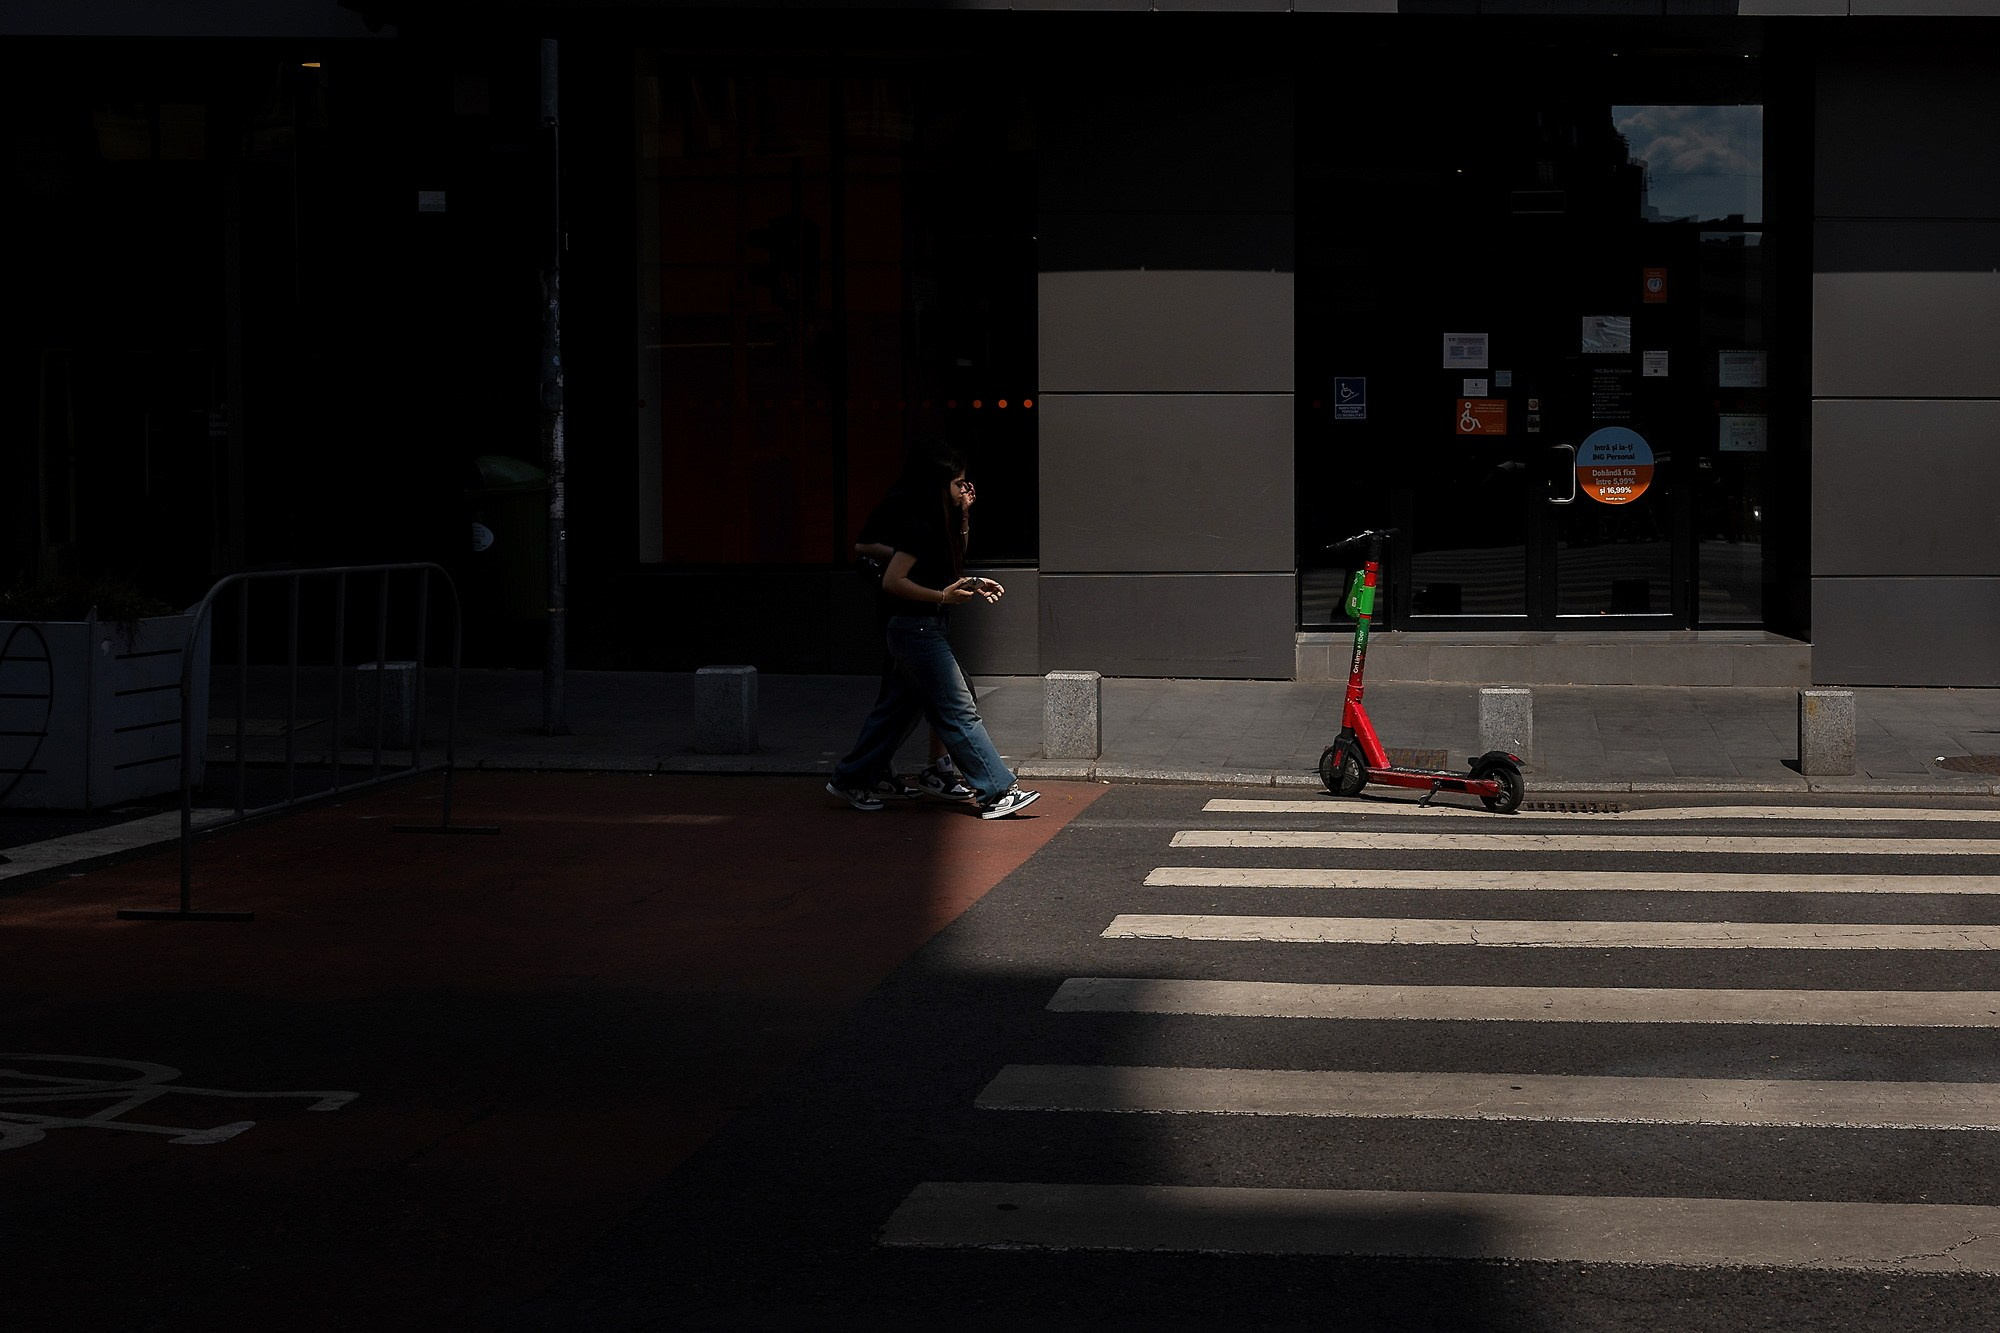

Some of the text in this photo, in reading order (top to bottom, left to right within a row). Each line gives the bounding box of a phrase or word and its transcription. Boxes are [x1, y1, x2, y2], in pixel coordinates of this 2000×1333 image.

[1594, 443, 1610, 451] Intră
[1592, 452, 1636, 461] ING Personal
[1592, 468, 1637, 477] Dobândă fixă
[1613, 477, 1635, 486] 5,99%
[1607, 486, 1632, 495] 16,99%
